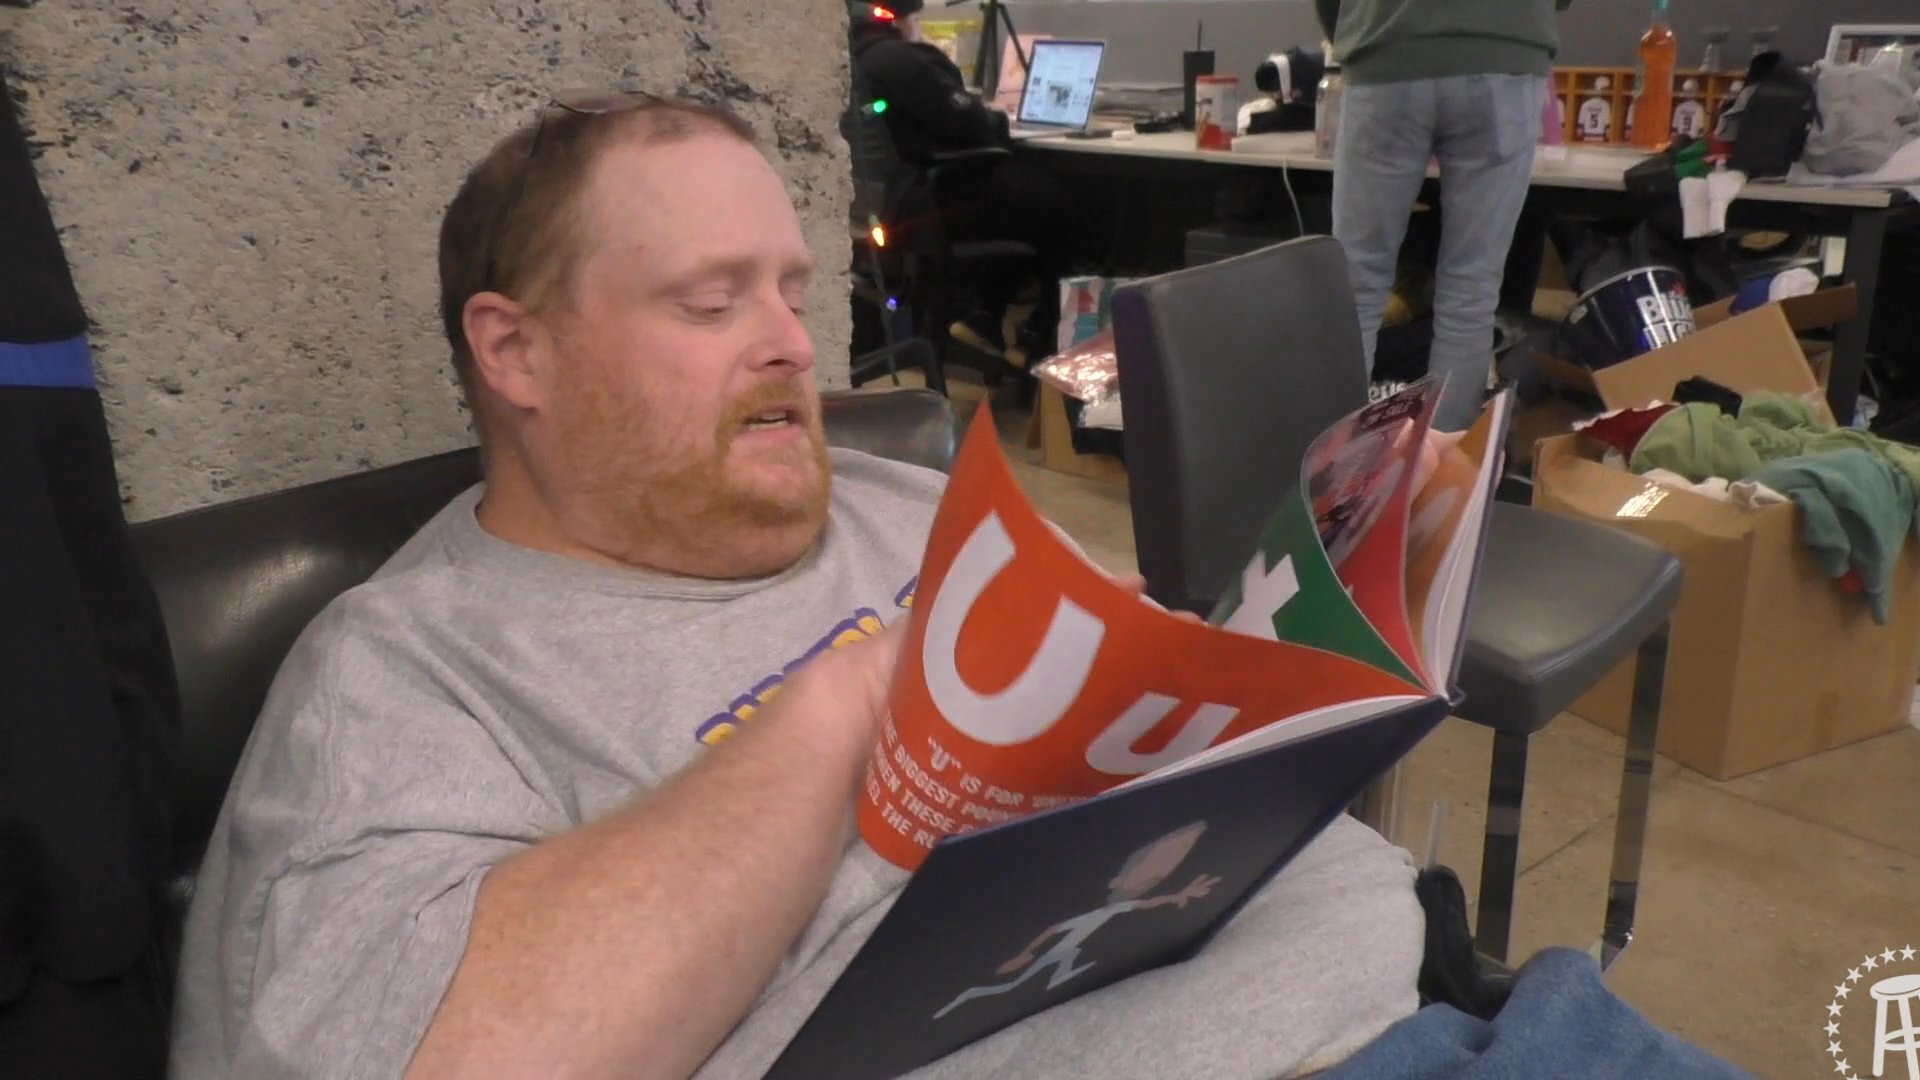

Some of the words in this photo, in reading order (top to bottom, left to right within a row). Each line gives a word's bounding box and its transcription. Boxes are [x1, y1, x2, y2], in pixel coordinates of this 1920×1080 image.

[923, 508, 1106, 746] U
[894, 743, 961, 809] BIGGEST
[959, 773, 982, 793] IS
[984, 785, 1025, 807] FOR
[881, 802, 912, 836] THE
[901, 788, 957, 833] THESE
